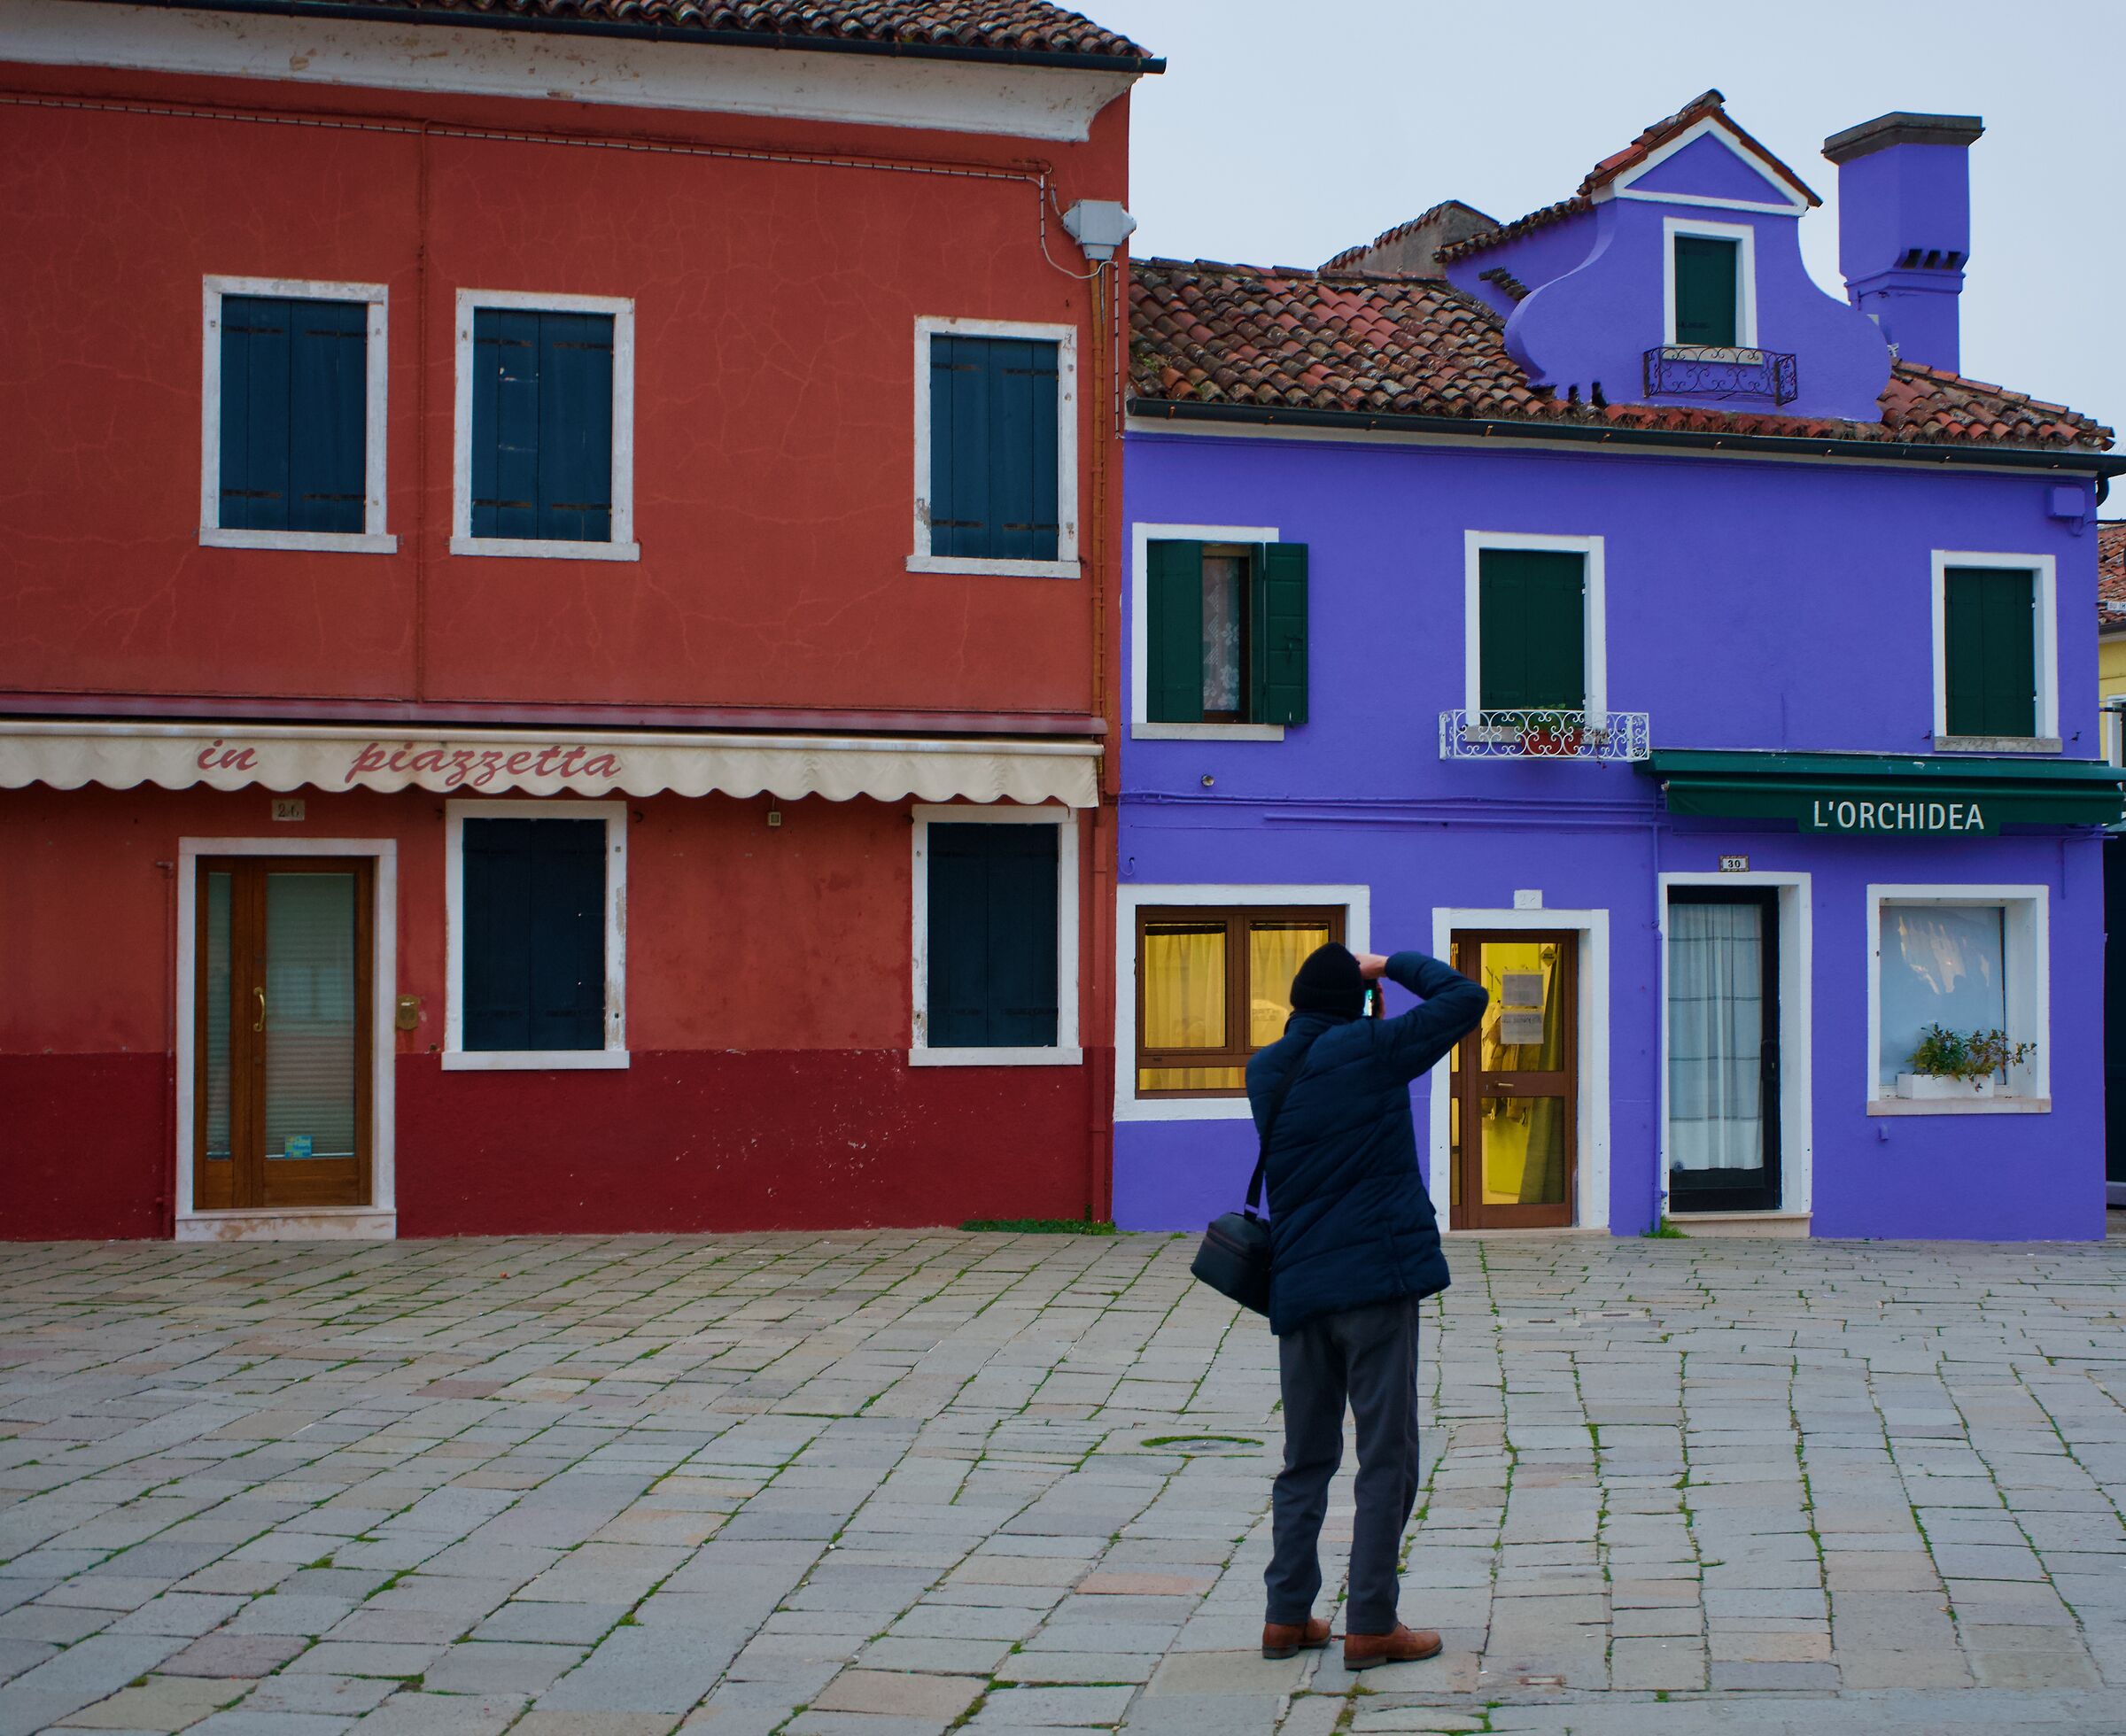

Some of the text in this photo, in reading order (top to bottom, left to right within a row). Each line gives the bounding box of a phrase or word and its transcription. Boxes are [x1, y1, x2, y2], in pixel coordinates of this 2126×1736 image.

[198, 740, 622, 787] in piazzetta
[1814, 801, 1985, 830] L'ORCHIDEA
[1727, 859, 1741, 869] 30
